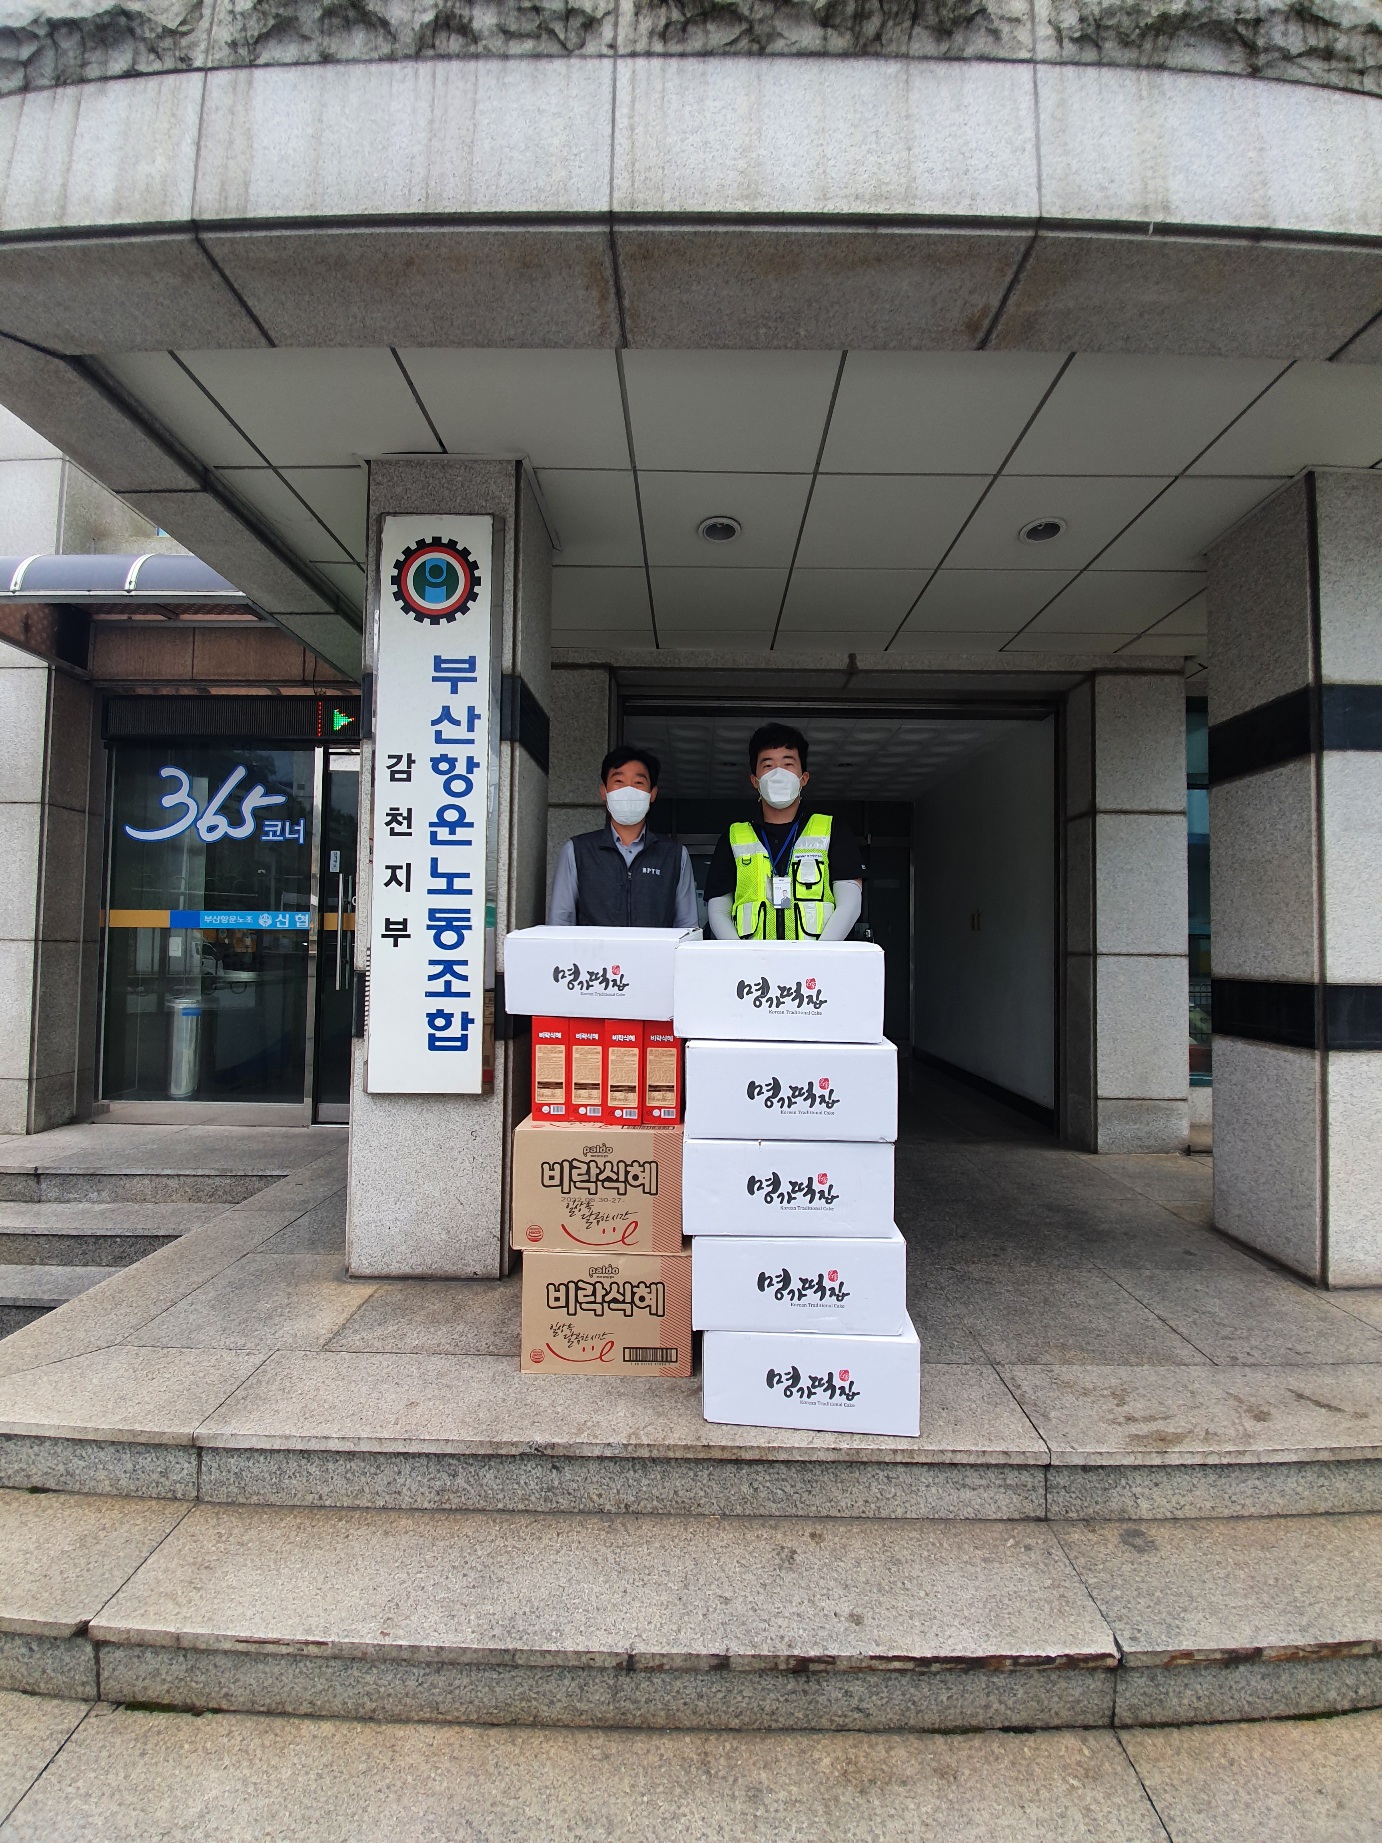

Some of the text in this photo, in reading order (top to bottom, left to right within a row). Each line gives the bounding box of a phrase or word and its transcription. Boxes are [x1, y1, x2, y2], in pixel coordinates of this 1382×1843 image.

[125, 765, 306, 844] 365 코너
[381, 753, 416, 948] 감천지부
[424, 655, 481, 1052] 부산항운노동조합
[204, 915, 253, 924] 부산항운노조
[553, 963, 629, 991] 명가떡집
[736, 976, 828, 1009] 명가떡집
[746, 1076, 840, 1109] 명가떡집
[583, 1143, 614, 1157] paldo
[541, 1158, 658, 1196] 비락식혜
[746, 1171, 840, 1205] 명가떡집
[589, 1264, 620, 1278] paldo
[757, 1267, 851, 1302] 명가떡집
[546, 1279, 665, 1317] 비락식혜
[765, 1365, 860, 1401] 명가떡집
